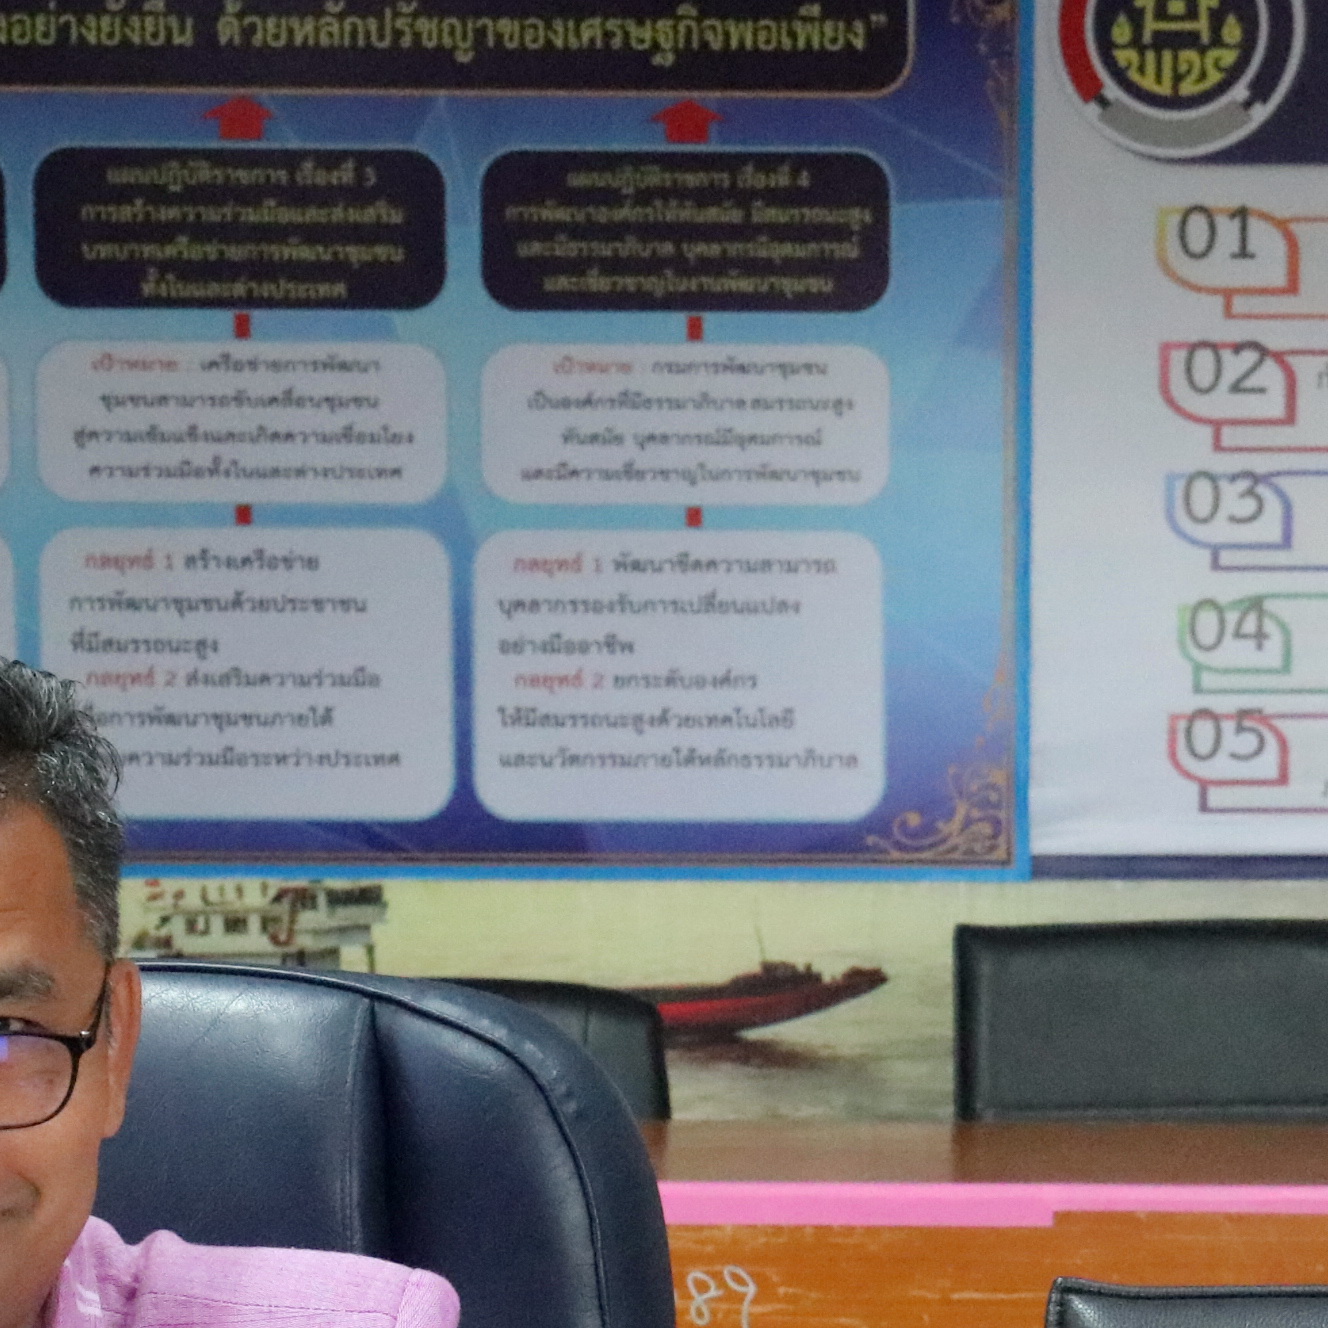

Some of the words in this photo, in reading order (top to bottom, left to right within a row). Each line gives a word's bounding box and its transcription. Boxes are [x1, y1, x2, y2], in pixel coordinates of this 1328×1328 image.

[1176, 206, 1258, 261] 01
[1182, 342, 1268, 396] 02
[1180, 470, 1266, 525] 03
[1186, 598, 1271, 652] 04
[163, 672, 177, 687] 2
[592, 672, 605, 688] 2
[1184, 708, 1267, 762] 05
